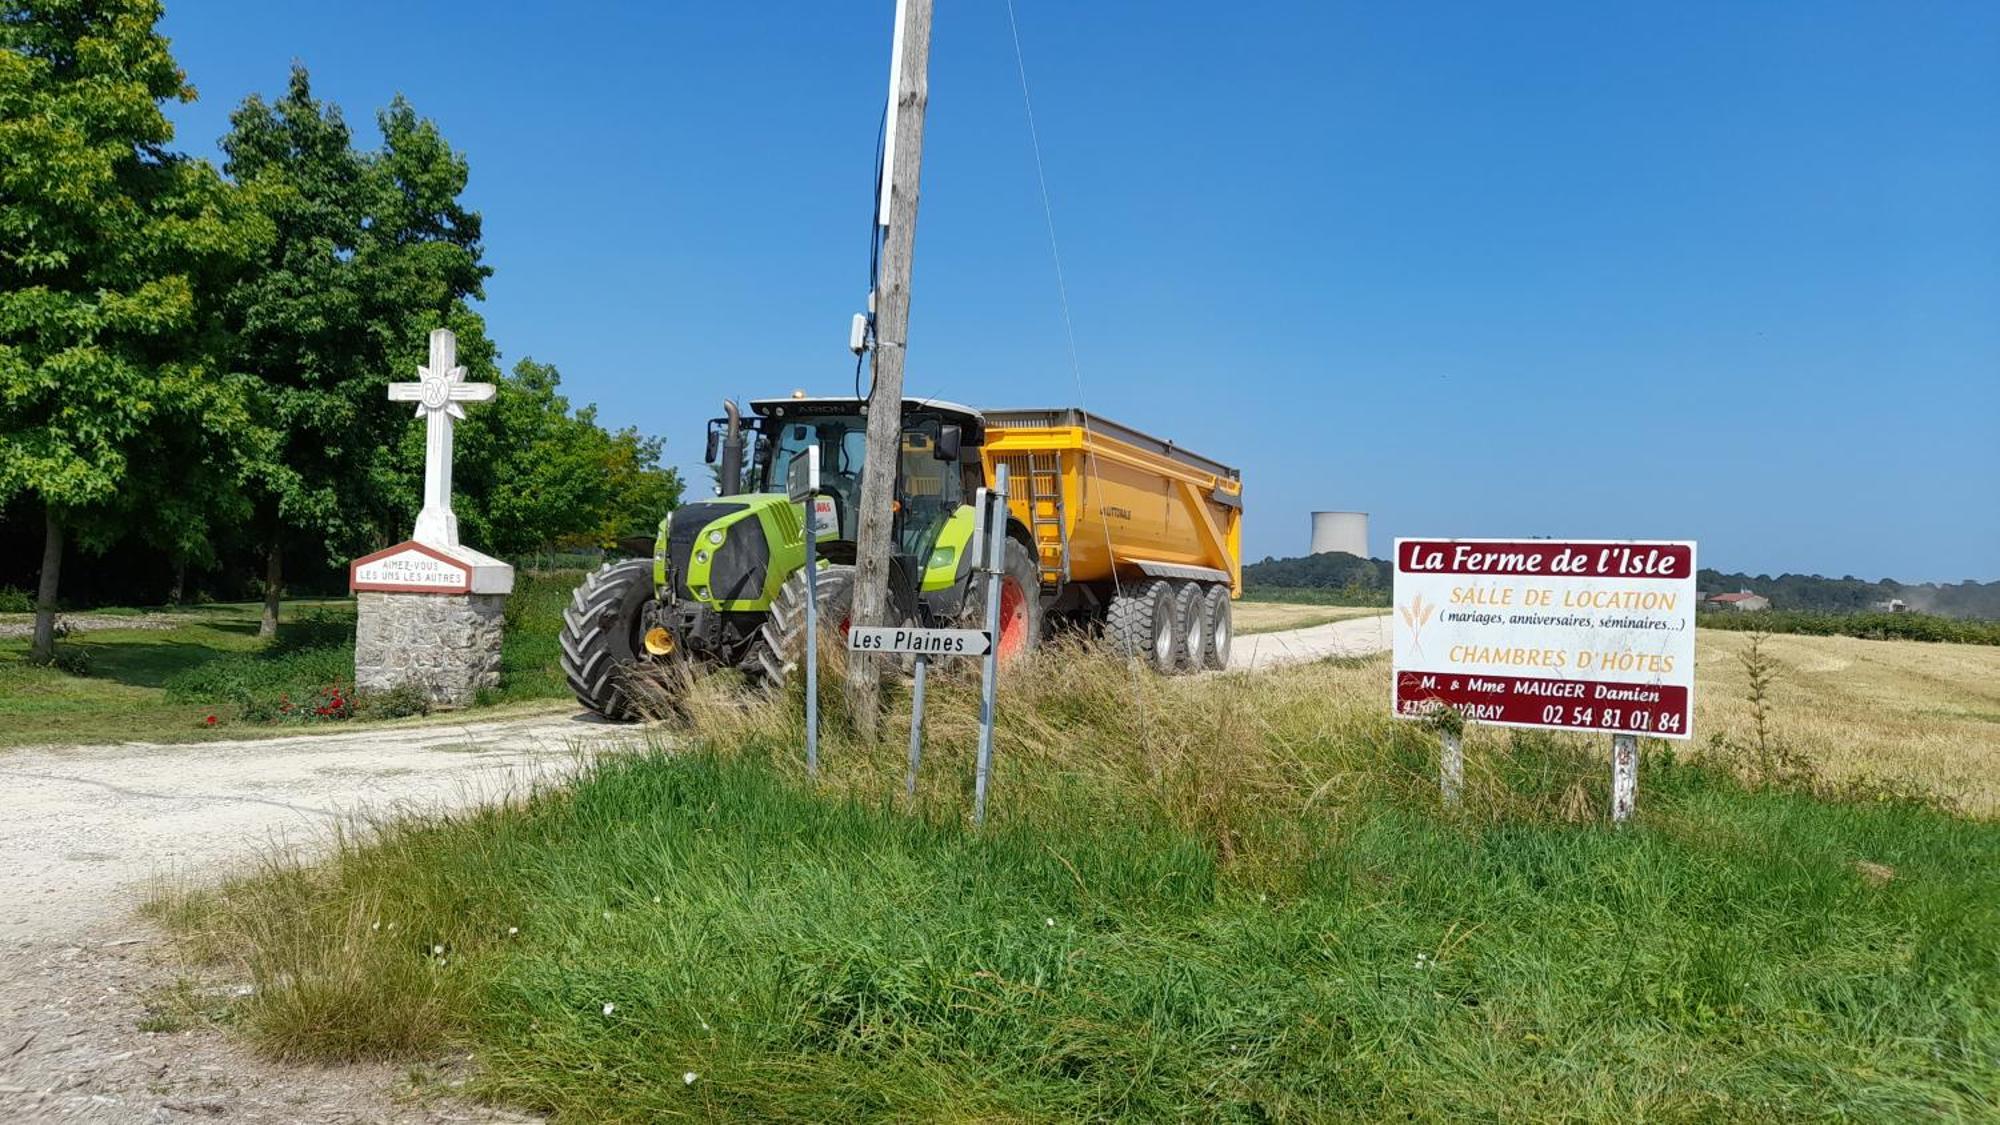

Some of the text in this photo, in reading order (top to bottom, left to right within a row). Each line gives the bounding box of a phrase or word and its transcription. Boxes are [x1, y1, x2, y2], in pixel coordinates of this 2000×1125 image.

[1410, 545, 1676, 575] La Ferme de l'Isle
[360, 570, 377, 580] LES
[404, 571, 421, 582] LES
[425, 572, 462, 584] AUTRES
[1450, 587, 1677, 611] SALLE DE LOCATION
[1509, 611, 1594, 629] anniversaires,
[853, 630, 964, 651] Les Plaines
[1450, 645, 1675, 673] CHAMBRES D'HÔTES
[1421, 676, 1660, 702] M. & Mme MAUGER Damien
[1543, 705, 1680, 732] 02 54 81 01 84
